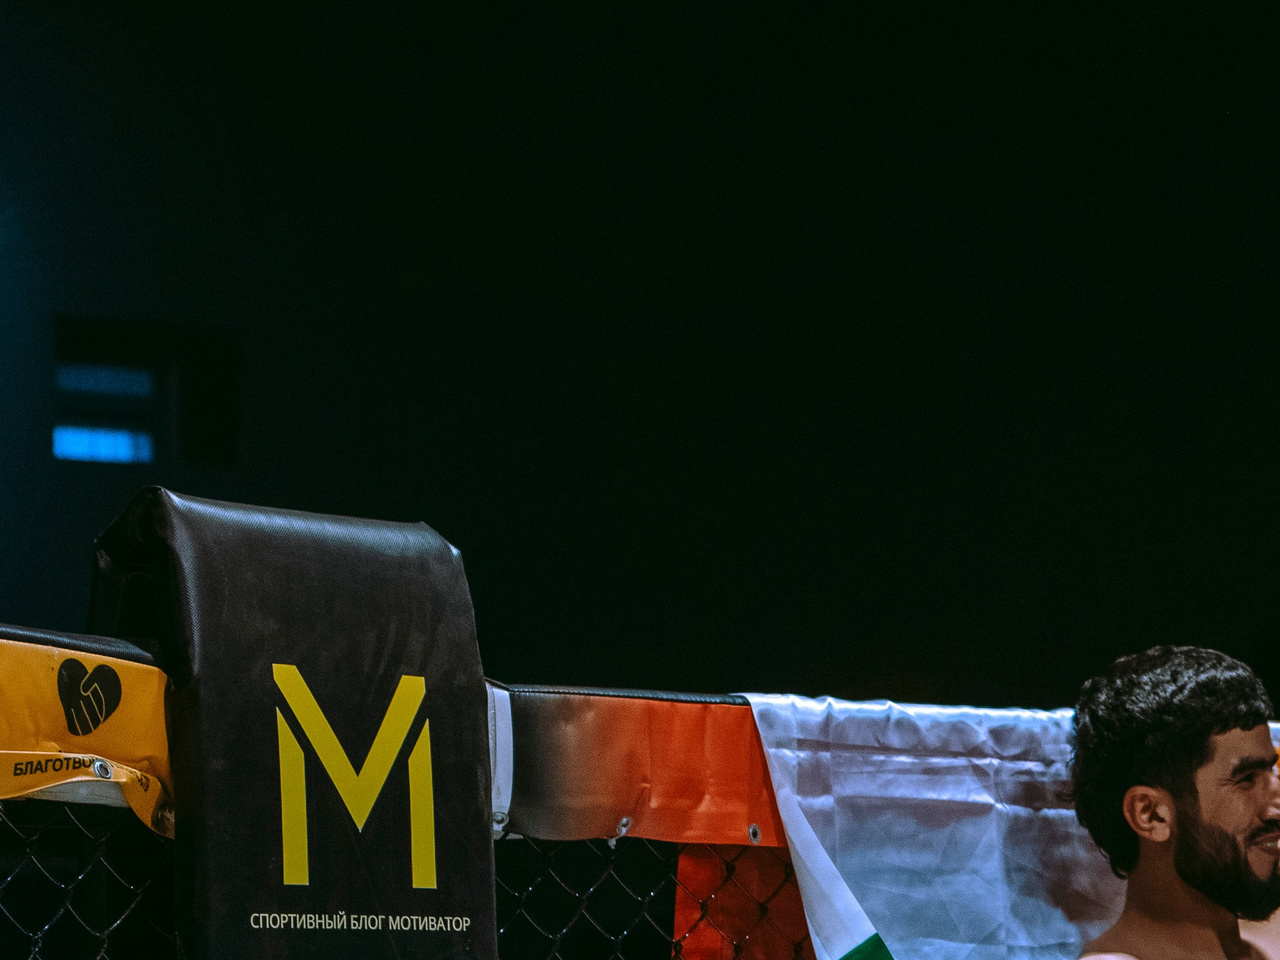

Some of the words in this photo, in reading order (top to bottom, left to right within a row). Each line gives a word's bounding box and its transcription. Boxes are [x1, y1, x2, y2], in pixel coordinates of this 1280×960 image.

[250, 910, 347, 930] СПОРТИВНЫЙ
[350, 914, 386, 931] БЛОГ
[388, 915, 471, 932] МОТИВАТОР
